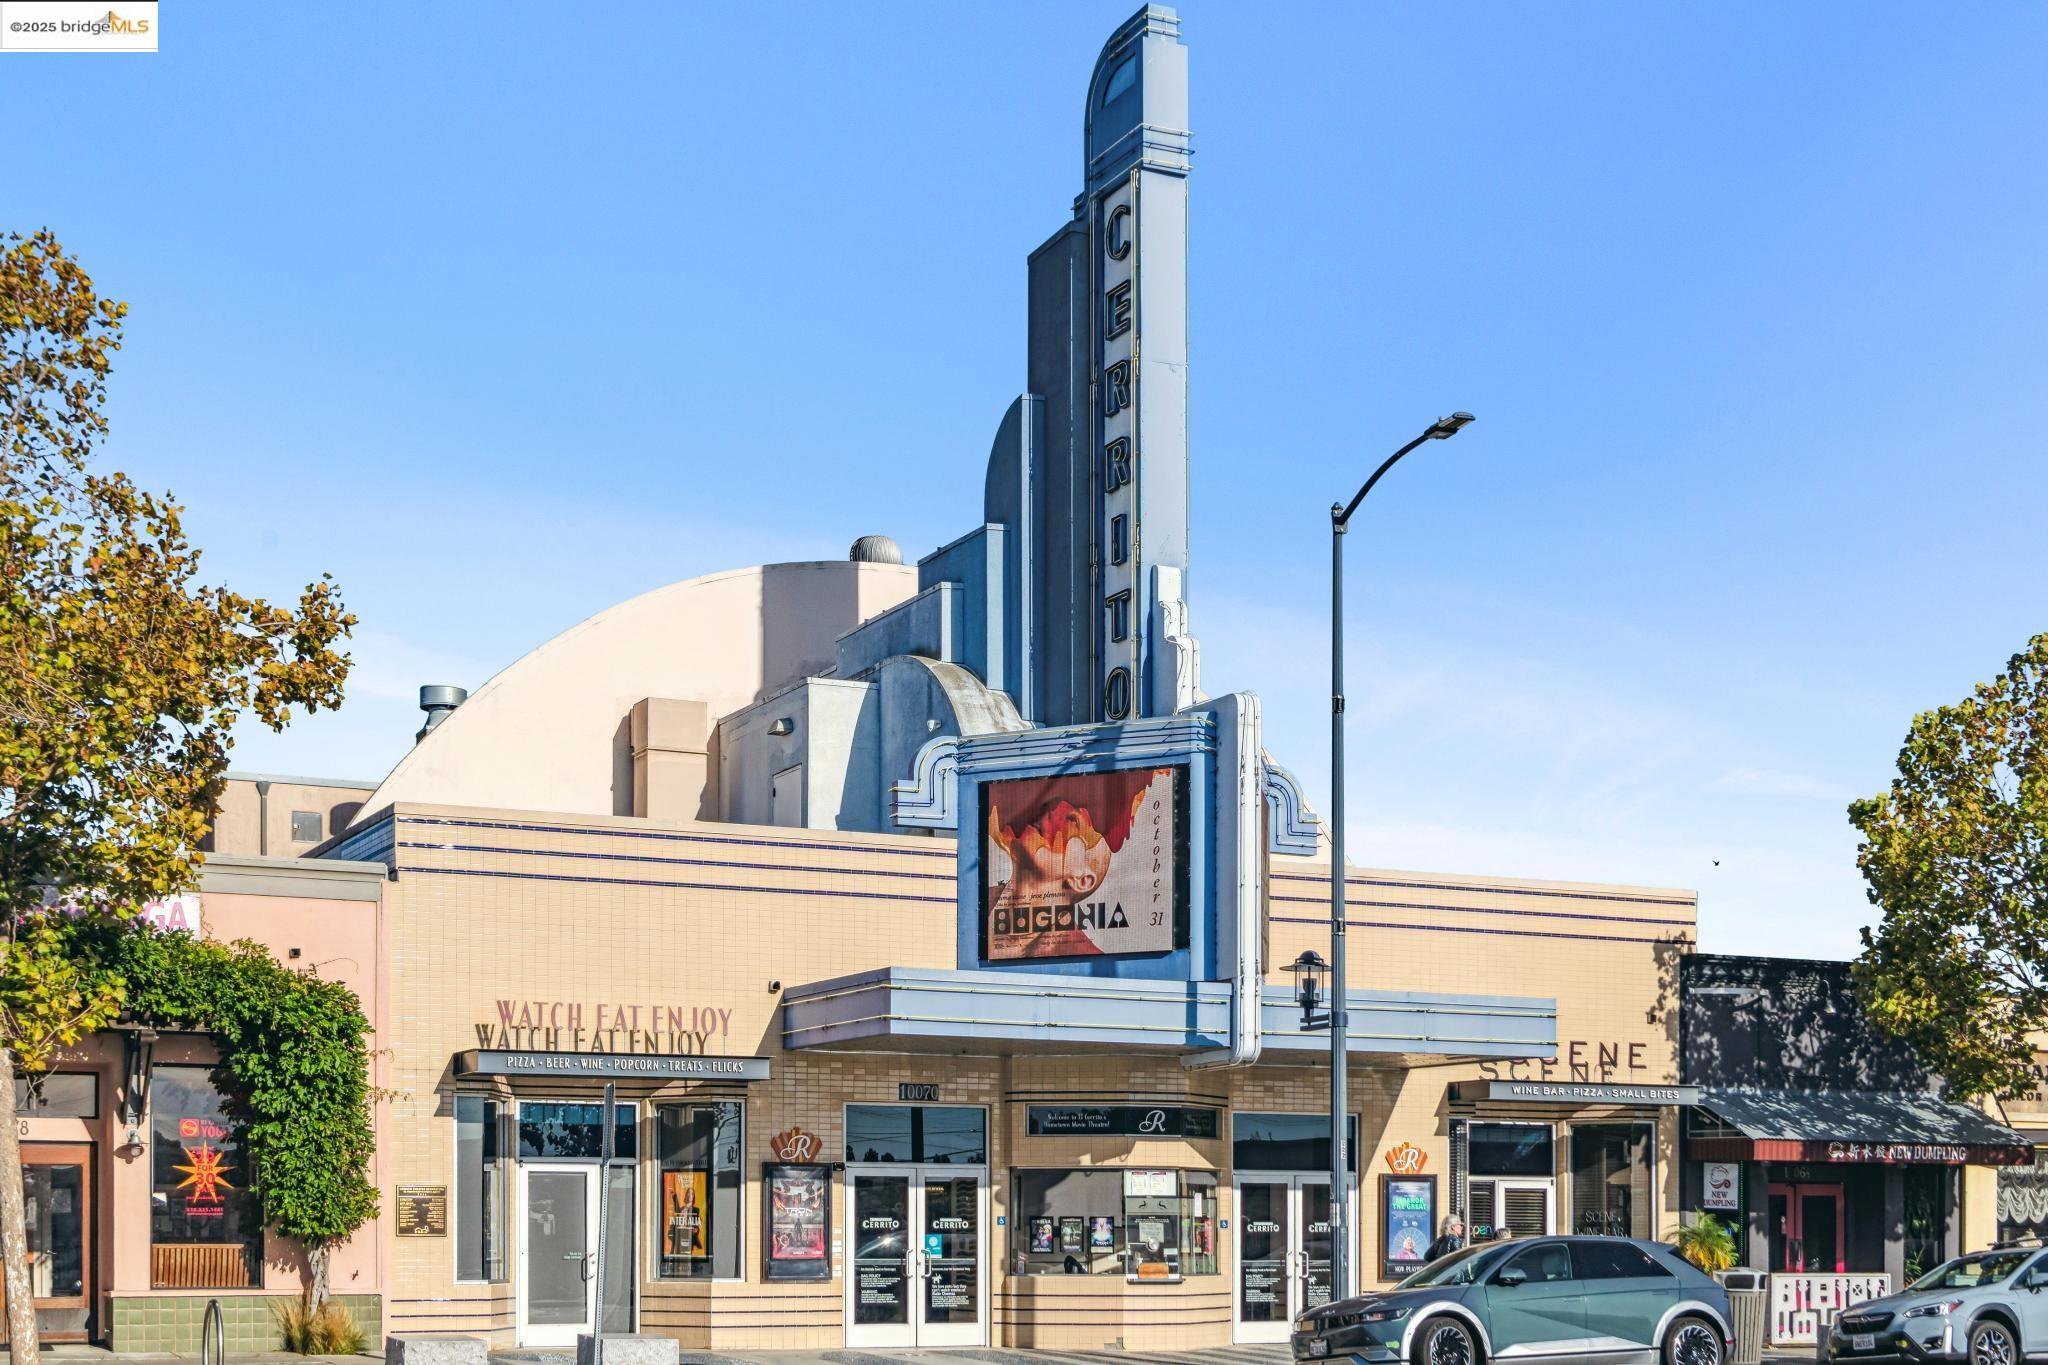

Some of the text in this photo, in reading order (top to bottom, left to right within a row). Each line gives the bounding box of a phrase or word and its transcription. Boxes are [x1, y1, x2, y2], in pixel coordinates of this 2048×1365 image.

[1105, 203, 1132, 721] CERRITO
[1152, 800, 1162, 904] october
[144, 899, 189, 930] GA
[993, 901, 1130, 936] BUGONIA
[1149, 911, 1164, 927] 31
[497, 999, 733, 1037] WATCH EAT ENJOY
[506, 1056, 745, 1073] PIZZA BEER WINE POPCORN TREATS FLICKS
[900, 1084, 939, 1100] 10070
[1512, 1085, 1680, 1100] WINE BAR PIZZA SMALL BITES
[1138, 1109, 1166, 1133] R
[780, 1135, 811, 1160] R
[1889, 1144, 1967, 1161] NEW DUMPLING
[197, 1164, 214, 1172] FOR
[1393, 1148, 1419, 1172] R
[197, 1172, 216, 1185] 30
[1711, 1191, 1729, 1199] NEW
[1703, 1199, 1737, 1208] DUMPLING
[862, 1220, 900, 1229] CERRITO
[932, 1220, 969, 1229] CERRITO
[1246, 1224, 1280, 1232] CERRITO
